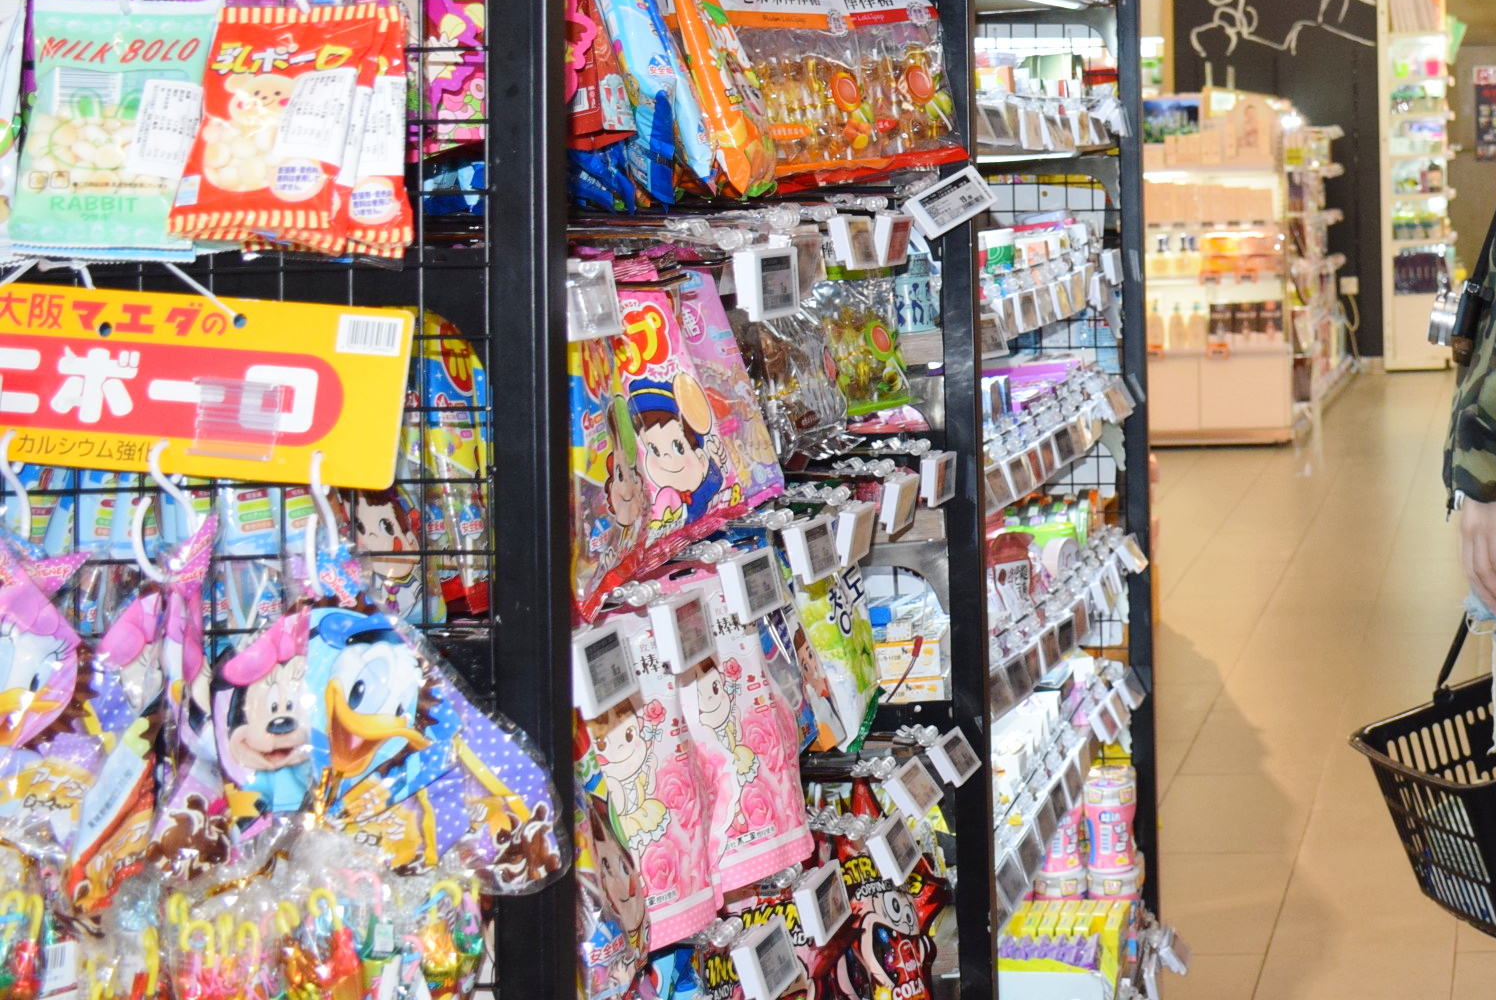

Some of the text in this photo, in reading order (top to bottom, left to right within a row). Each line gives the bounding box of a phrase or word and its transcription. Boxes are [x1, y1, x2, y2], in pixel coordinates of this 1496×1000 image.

[39, 35, 201, 64] MILK BOLO
[210, 41, 354, 75] 乳ボーロ
[50, 196, 140, 213] RABBIT
[0, 291, 228, 337] 大阪マエダの
